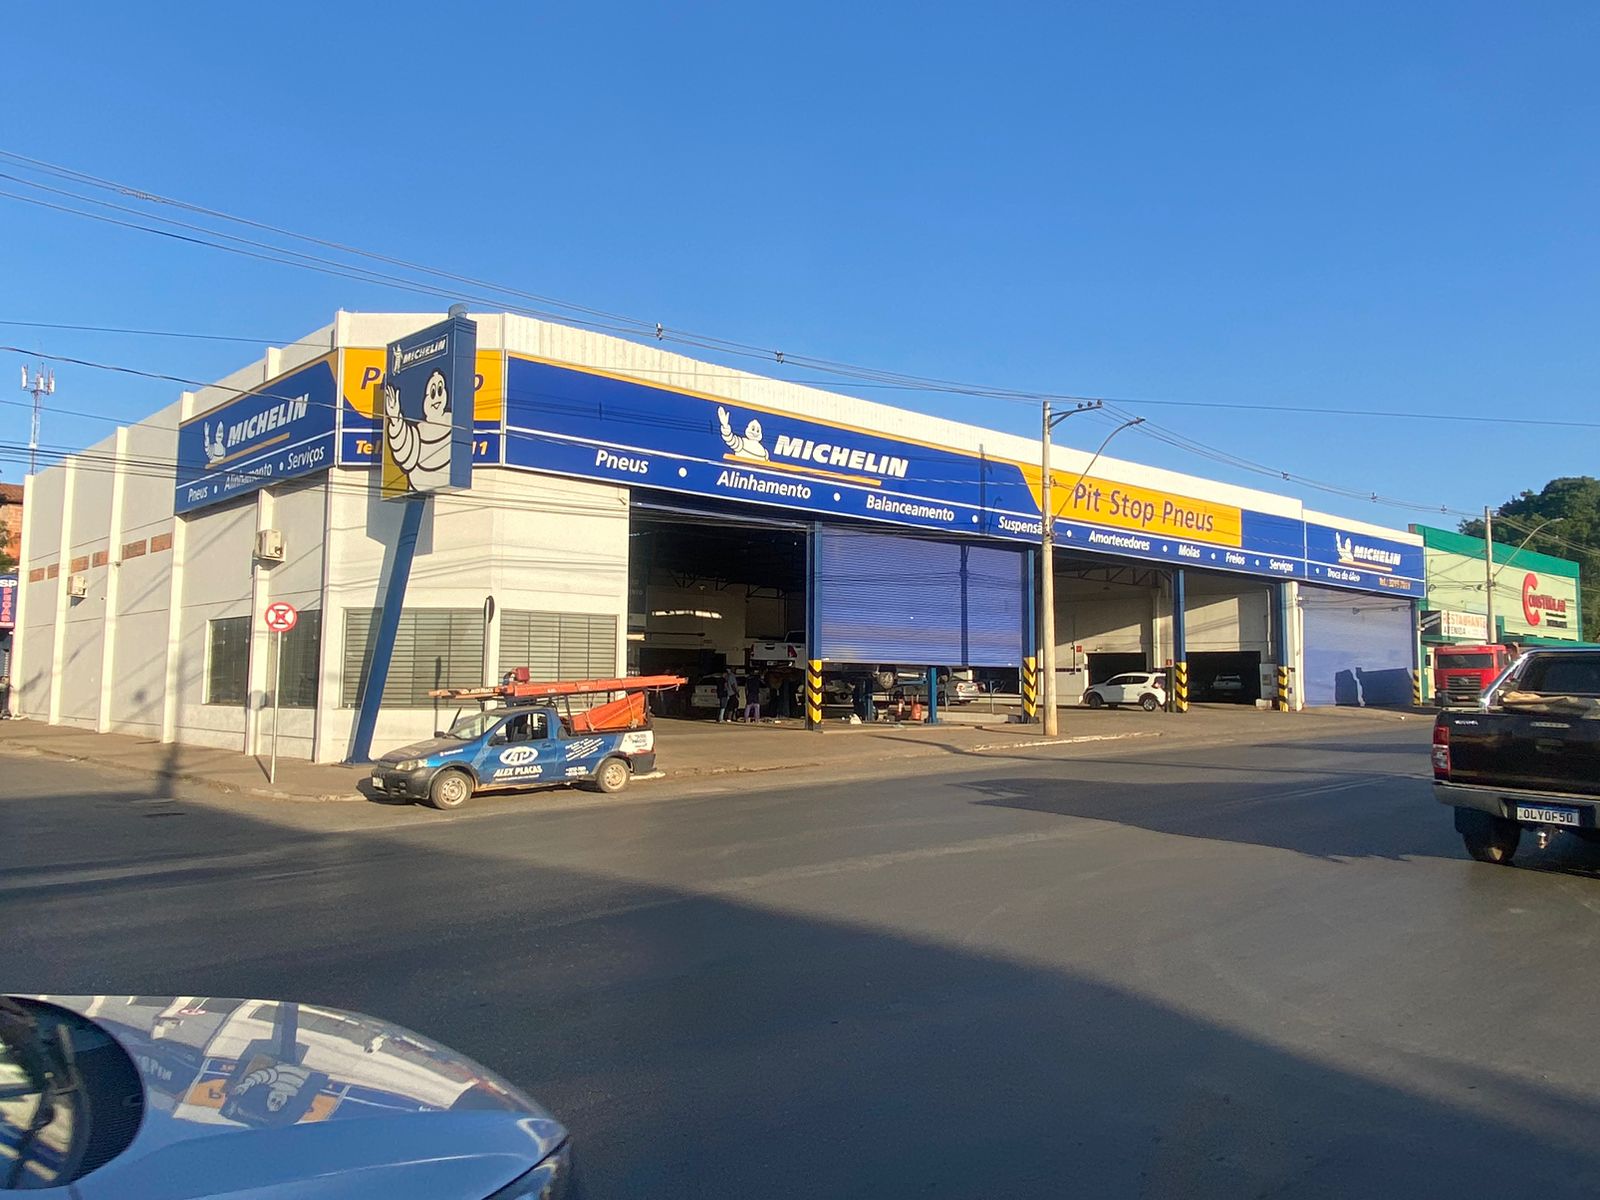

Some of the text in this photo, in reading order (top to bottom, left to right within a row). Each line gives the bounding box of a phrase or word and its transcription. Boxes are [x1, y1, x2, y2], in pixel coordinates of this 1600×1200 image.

[403, 339, 446, 364] MICHELIN
[226, 393, 309, 448] MICHELIN
[187, 485, 208, 502] Pneus
[287, 446, 325, 470] Serviços
[773, 434, 909, 478] MICHELIN
[595, 450, 649, 474] Pneus
[716, 470, 811, 499] Alinhamento
[866, 494, 955, 522] Balanceamento
[997, 515, 1042, 535] Suspensã
[1088, 530, 1150, 551] Amortecedores
[1178, 544, 1200, 559] Molas
[1225, 552, 1245, 566] Freios
[1269, 558, 1294, 573] Serviços
[1327, 567, 1341, 578] Troca
[1341, 570, 1349, 580] de
[1073, 483, 1214, 532] Pit Stop Pneus
[1353, 545, 1401, 566] MICHELIN
[493, 768, 513, 778] ALEX
[515, 765, 543, 776] PLACAS
